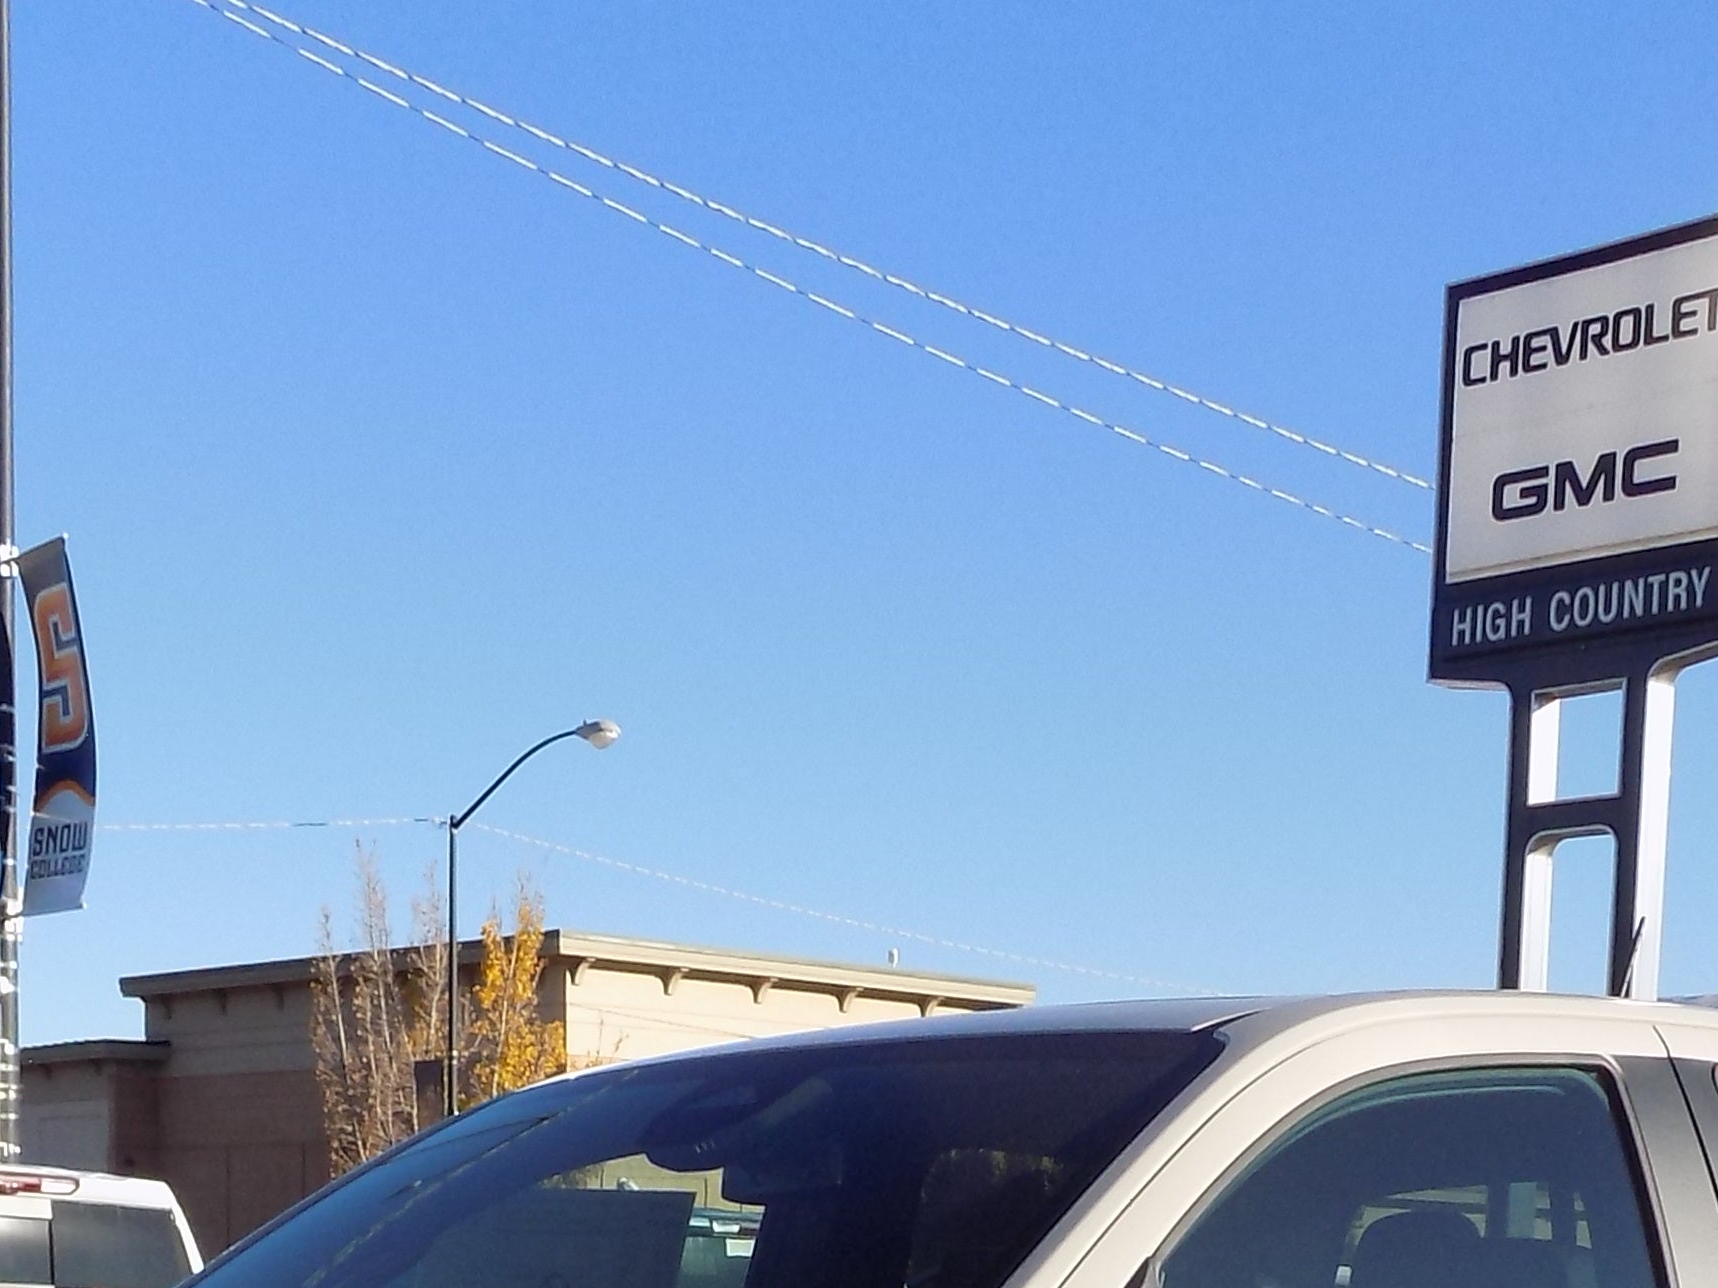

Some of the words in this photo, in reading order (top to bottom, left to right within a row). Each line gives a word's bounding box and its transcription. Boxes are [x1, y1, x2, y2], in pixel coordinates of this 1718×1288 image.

[1491, 439, 1679, 522] GMC
[1451, 597, 1532, 647] HIGH
[1550, 567, 1711, 632] COUNTRY
[33, 821, 89, 857] SNOW
